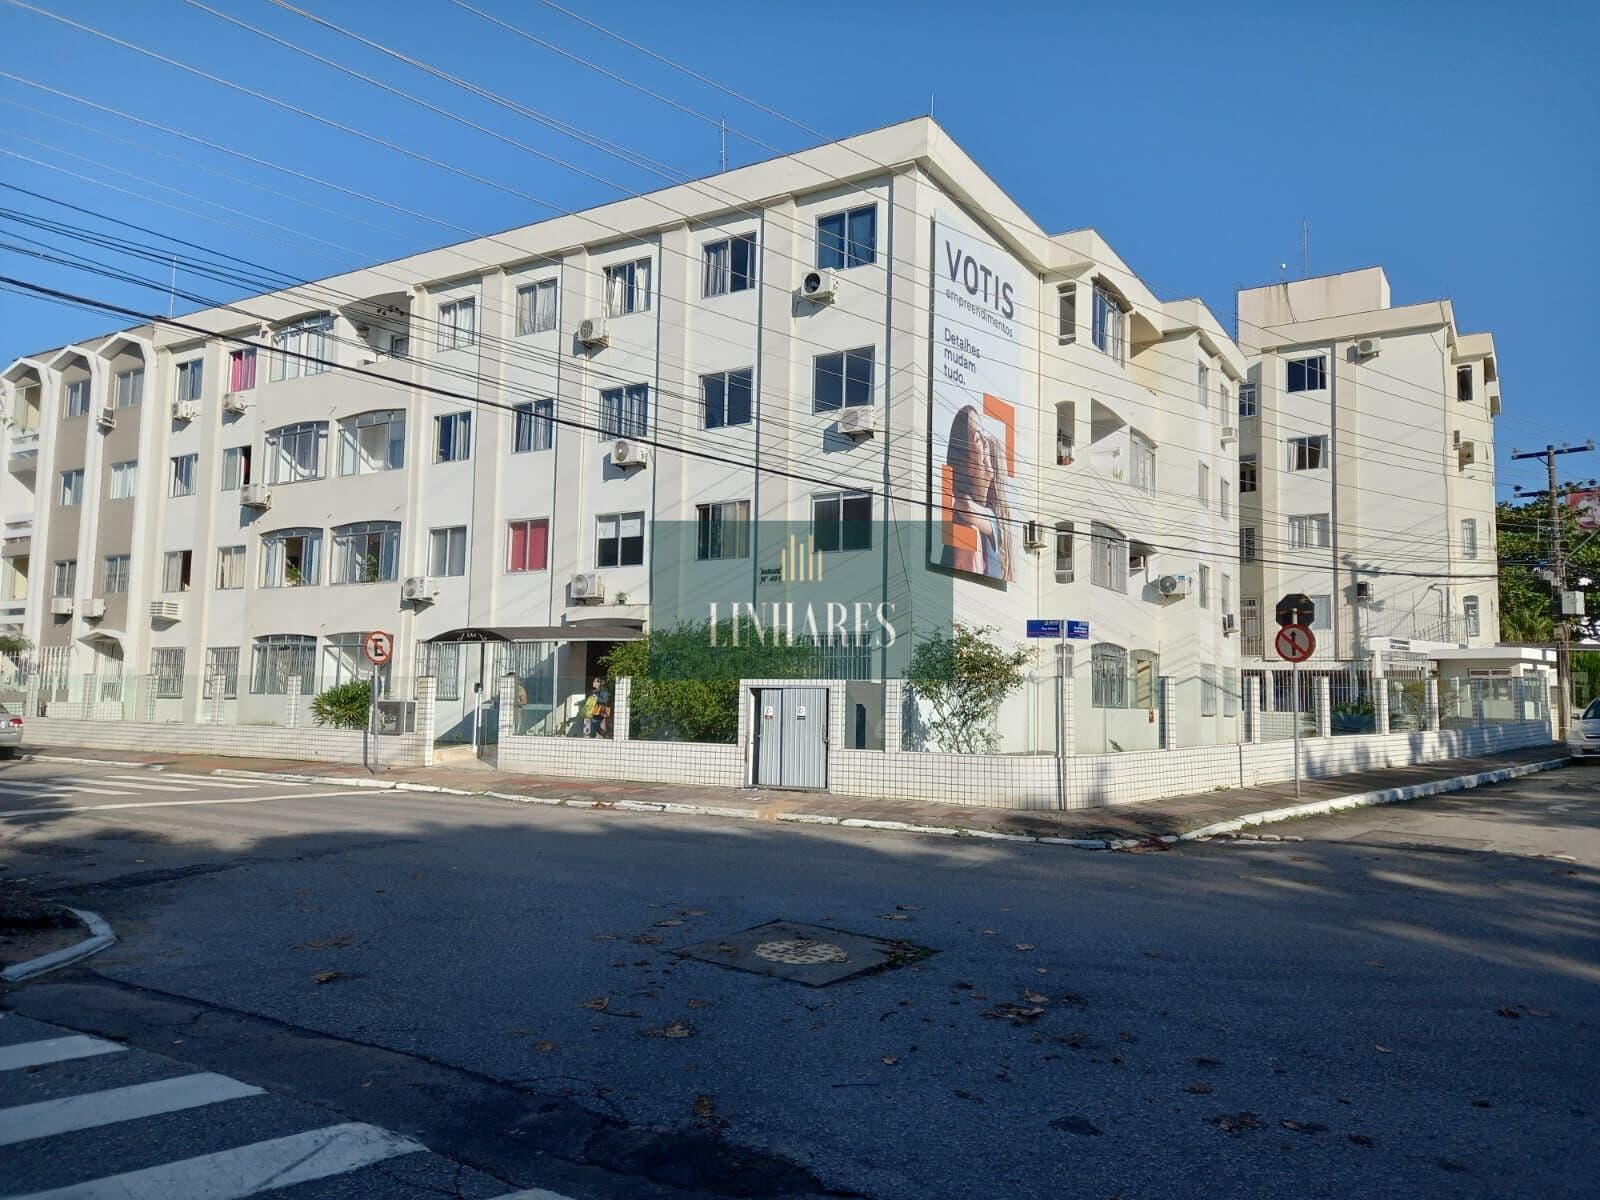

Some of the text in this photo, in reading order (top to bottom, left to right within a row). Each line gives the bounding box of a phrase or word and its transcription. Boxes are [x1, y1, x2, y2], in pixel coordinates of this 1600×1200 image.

[945, 239, 1014, 320] VOTIS
[945, 287, 1013, 338] empreendimentos
[944, 327, 980, 359] Detalhes
[944, 348, 976, 374] mudam
[944, 364, 966, 385] tudo.
